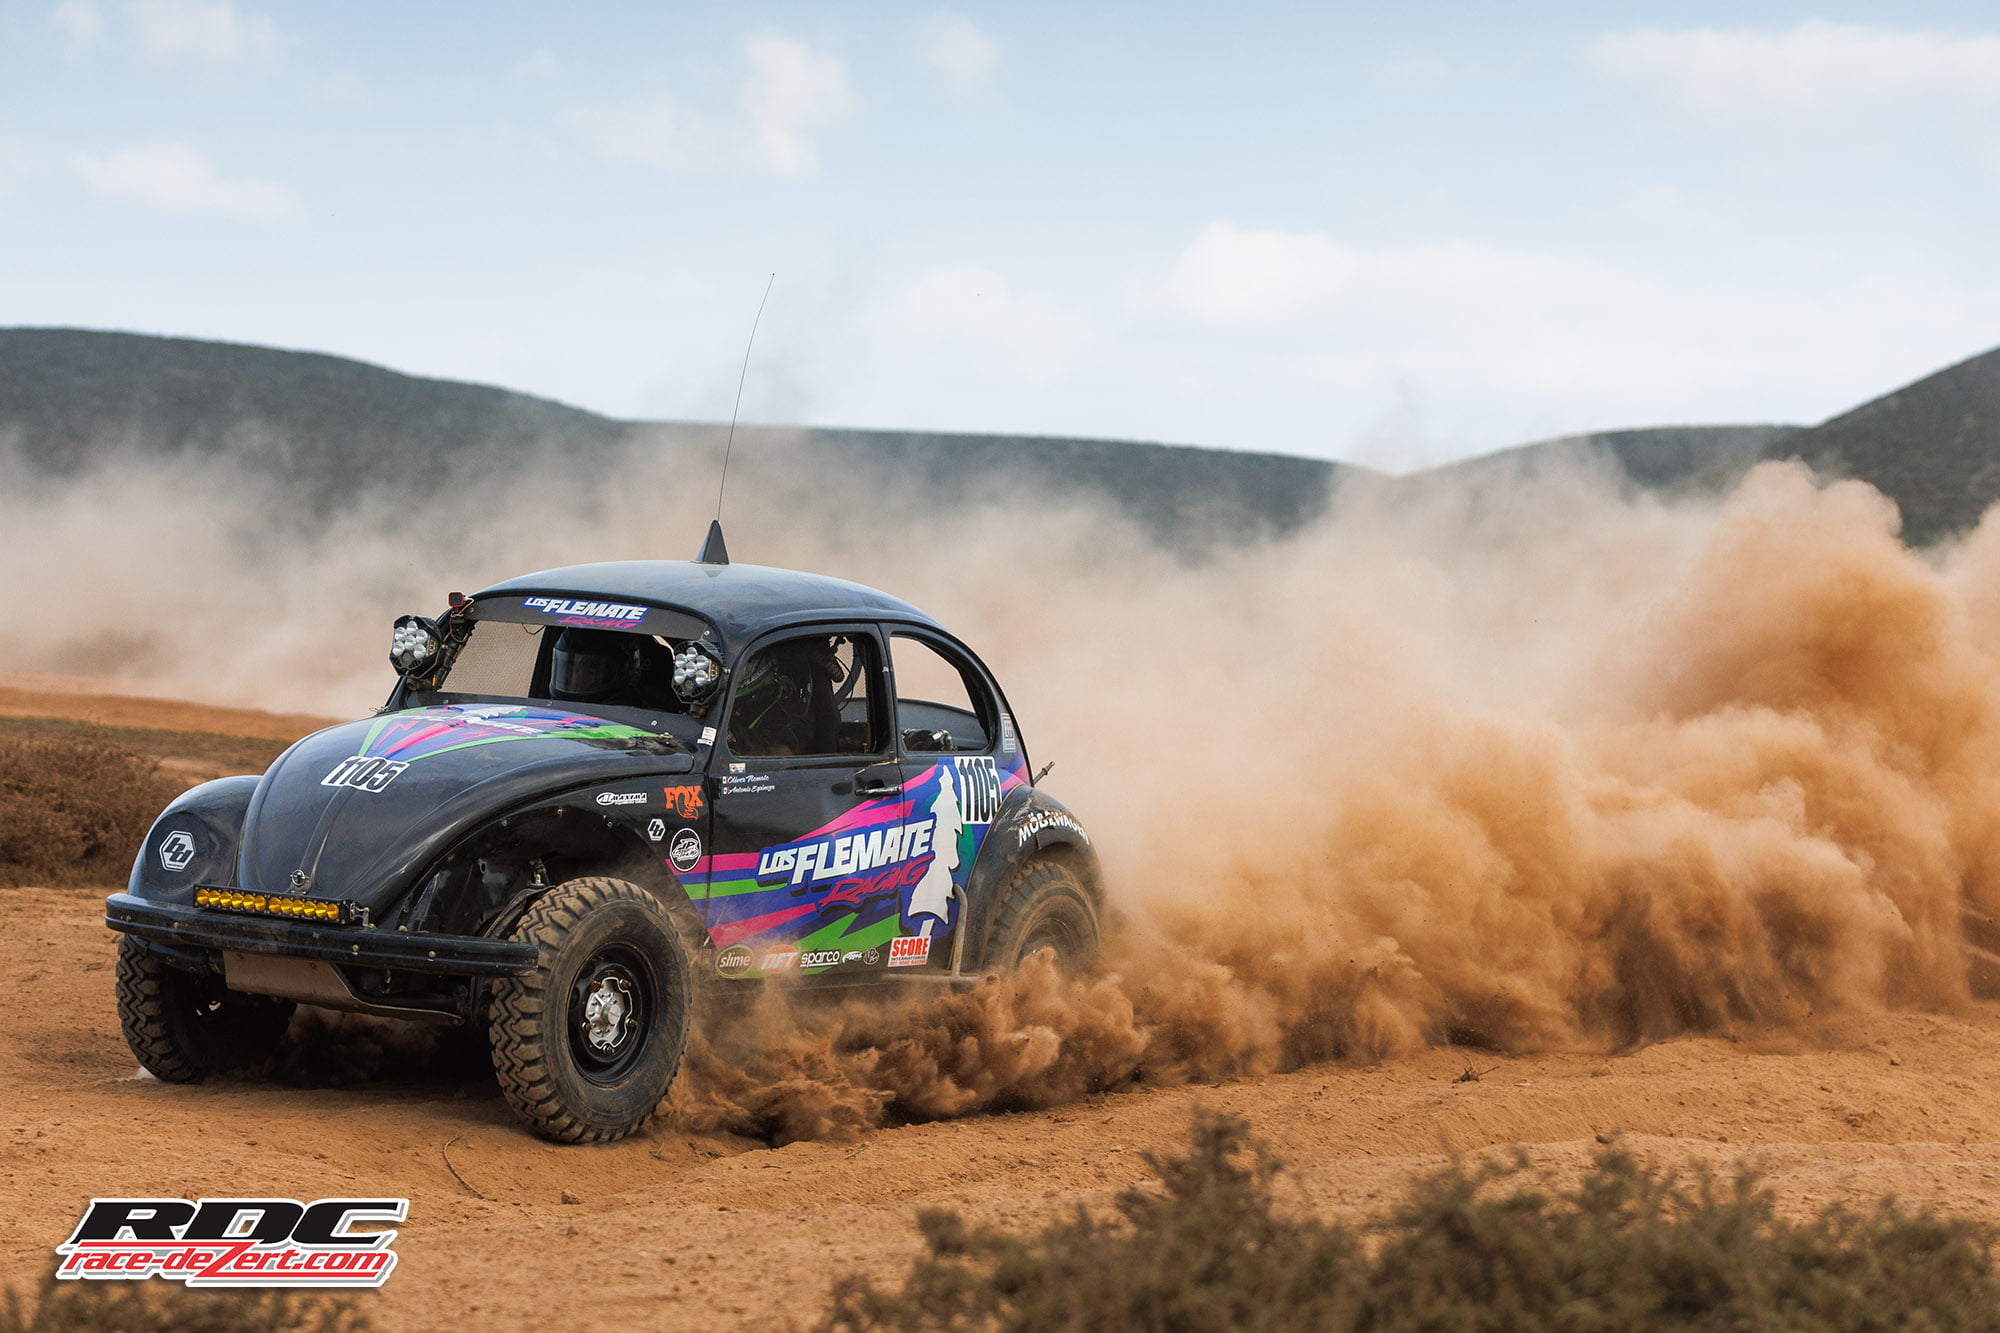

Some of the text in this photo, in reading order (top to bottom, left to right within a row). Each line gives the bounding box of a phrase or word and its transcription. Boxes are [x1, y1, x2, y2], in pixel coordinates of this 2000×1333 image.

[525, 597, 648, 620] LOS FLEMATE
[330, 757, 404, 790] 1105
[958, 758, 1001, 822] 1105
[663, 785, 703, 819] FOX
[758, 819, 935, 885] LOS FLEMATE
[818, 855, 936, 905] RACING
[719, 951, 751, 968] slime
[801, 950, 840, 967] sparco
[892, 938, 929, 957] SCORE
